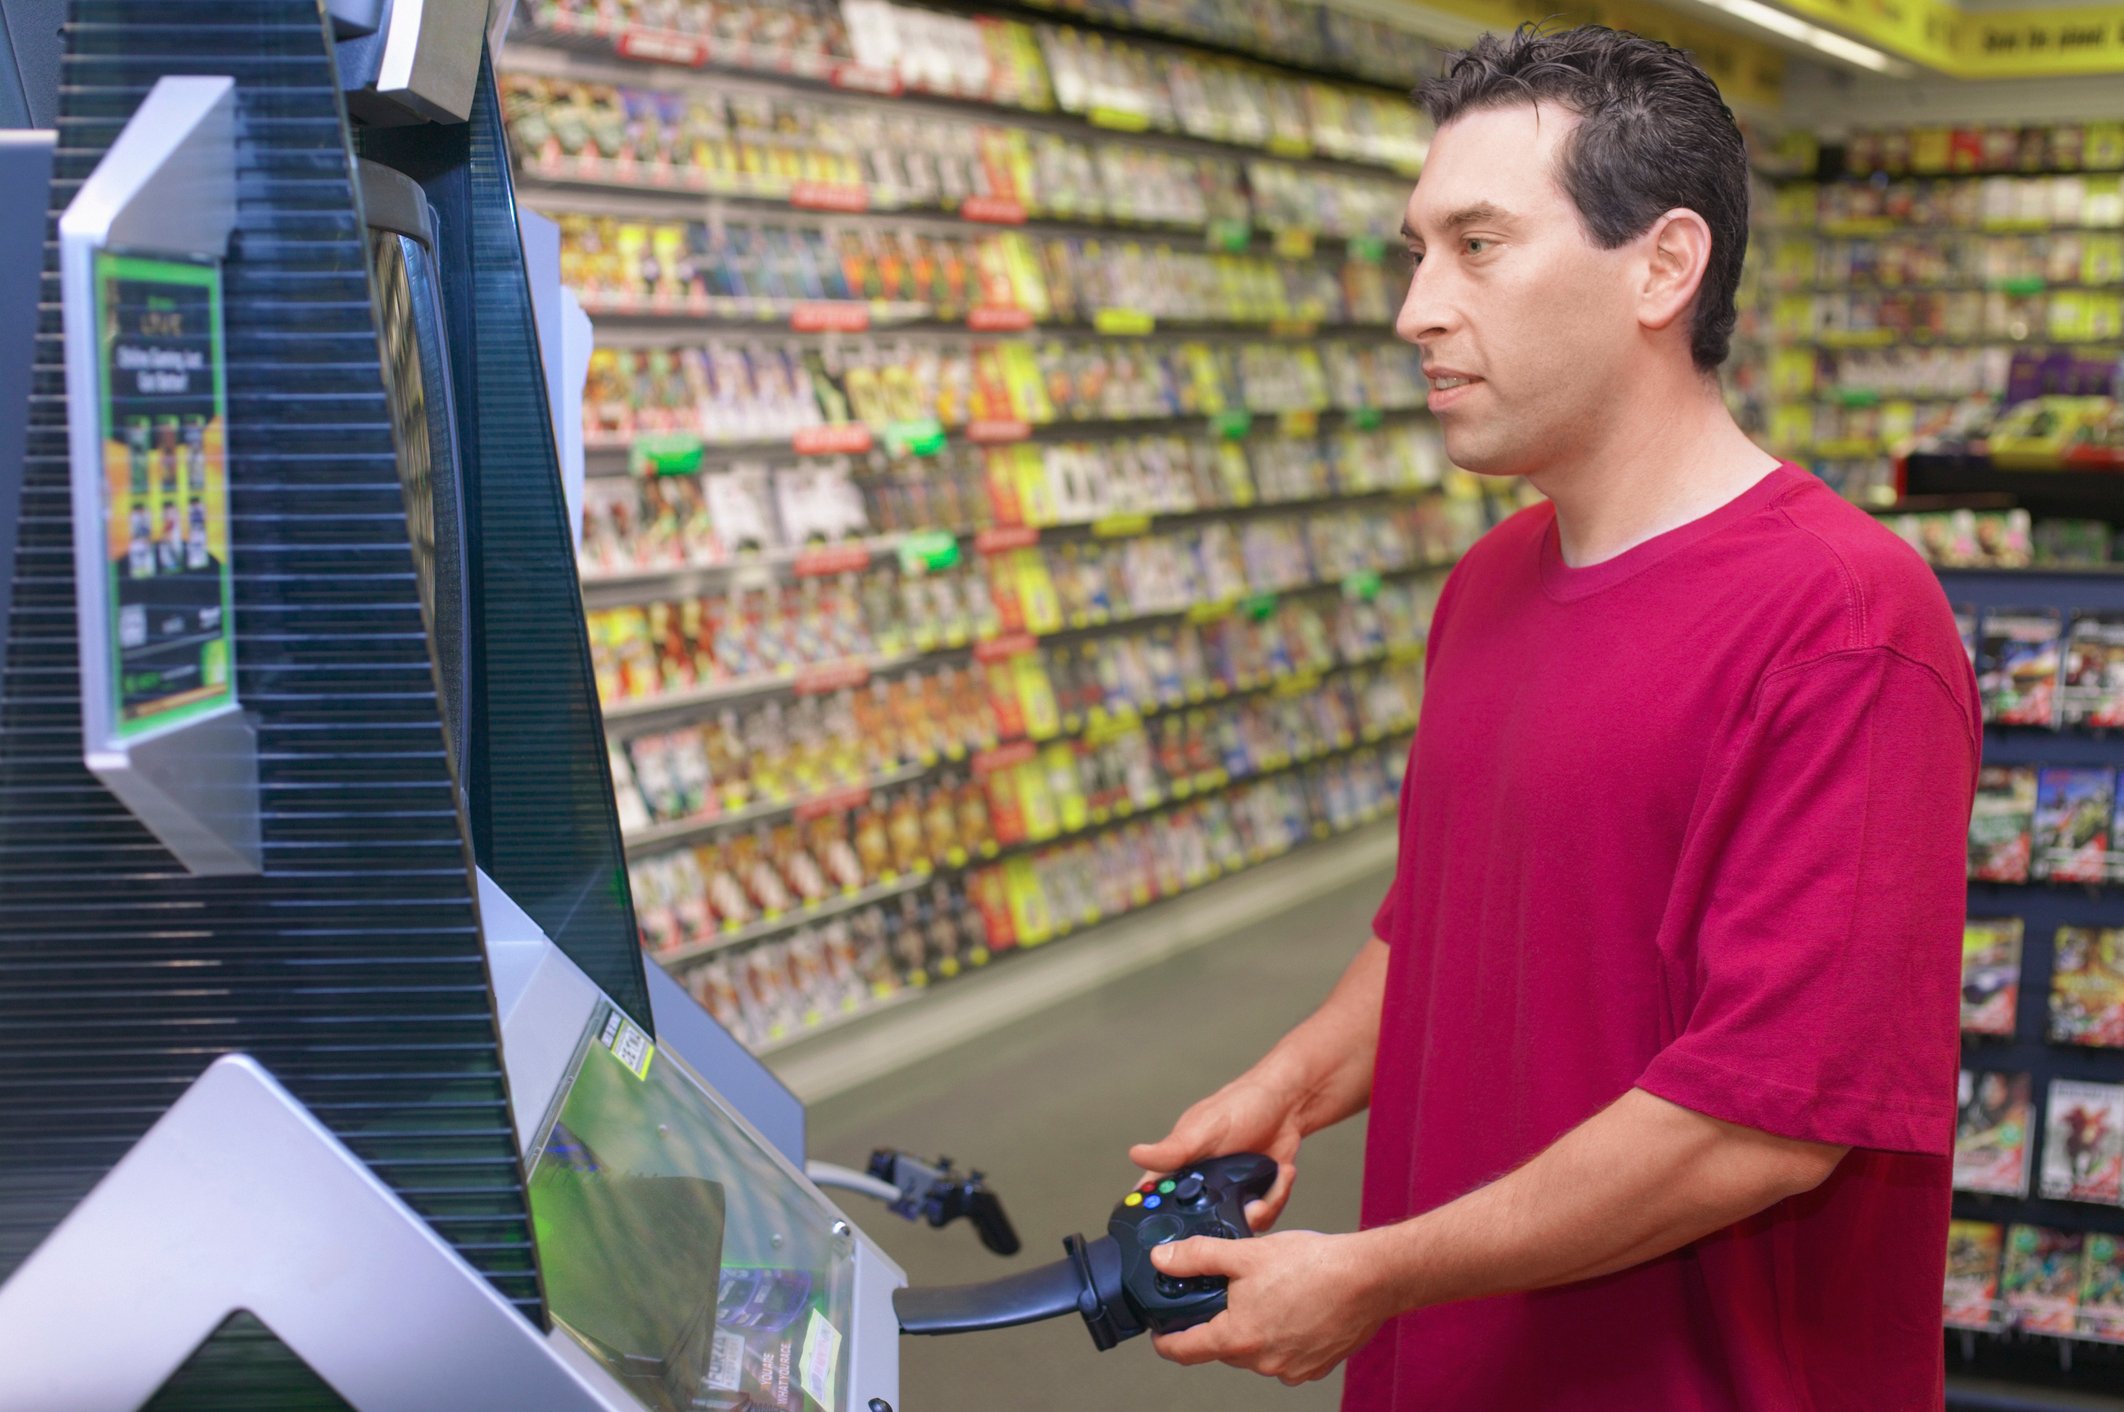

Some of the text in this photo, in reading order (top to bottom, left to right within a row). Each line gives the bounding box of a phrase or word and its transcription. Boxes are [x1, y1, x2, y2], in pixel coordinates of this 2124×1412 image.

[760, 1352, 775, 1386] YOU ARE
[778, 1365, 791, 1382] YOU
[777, 1381, 790, 1405] WHAT
